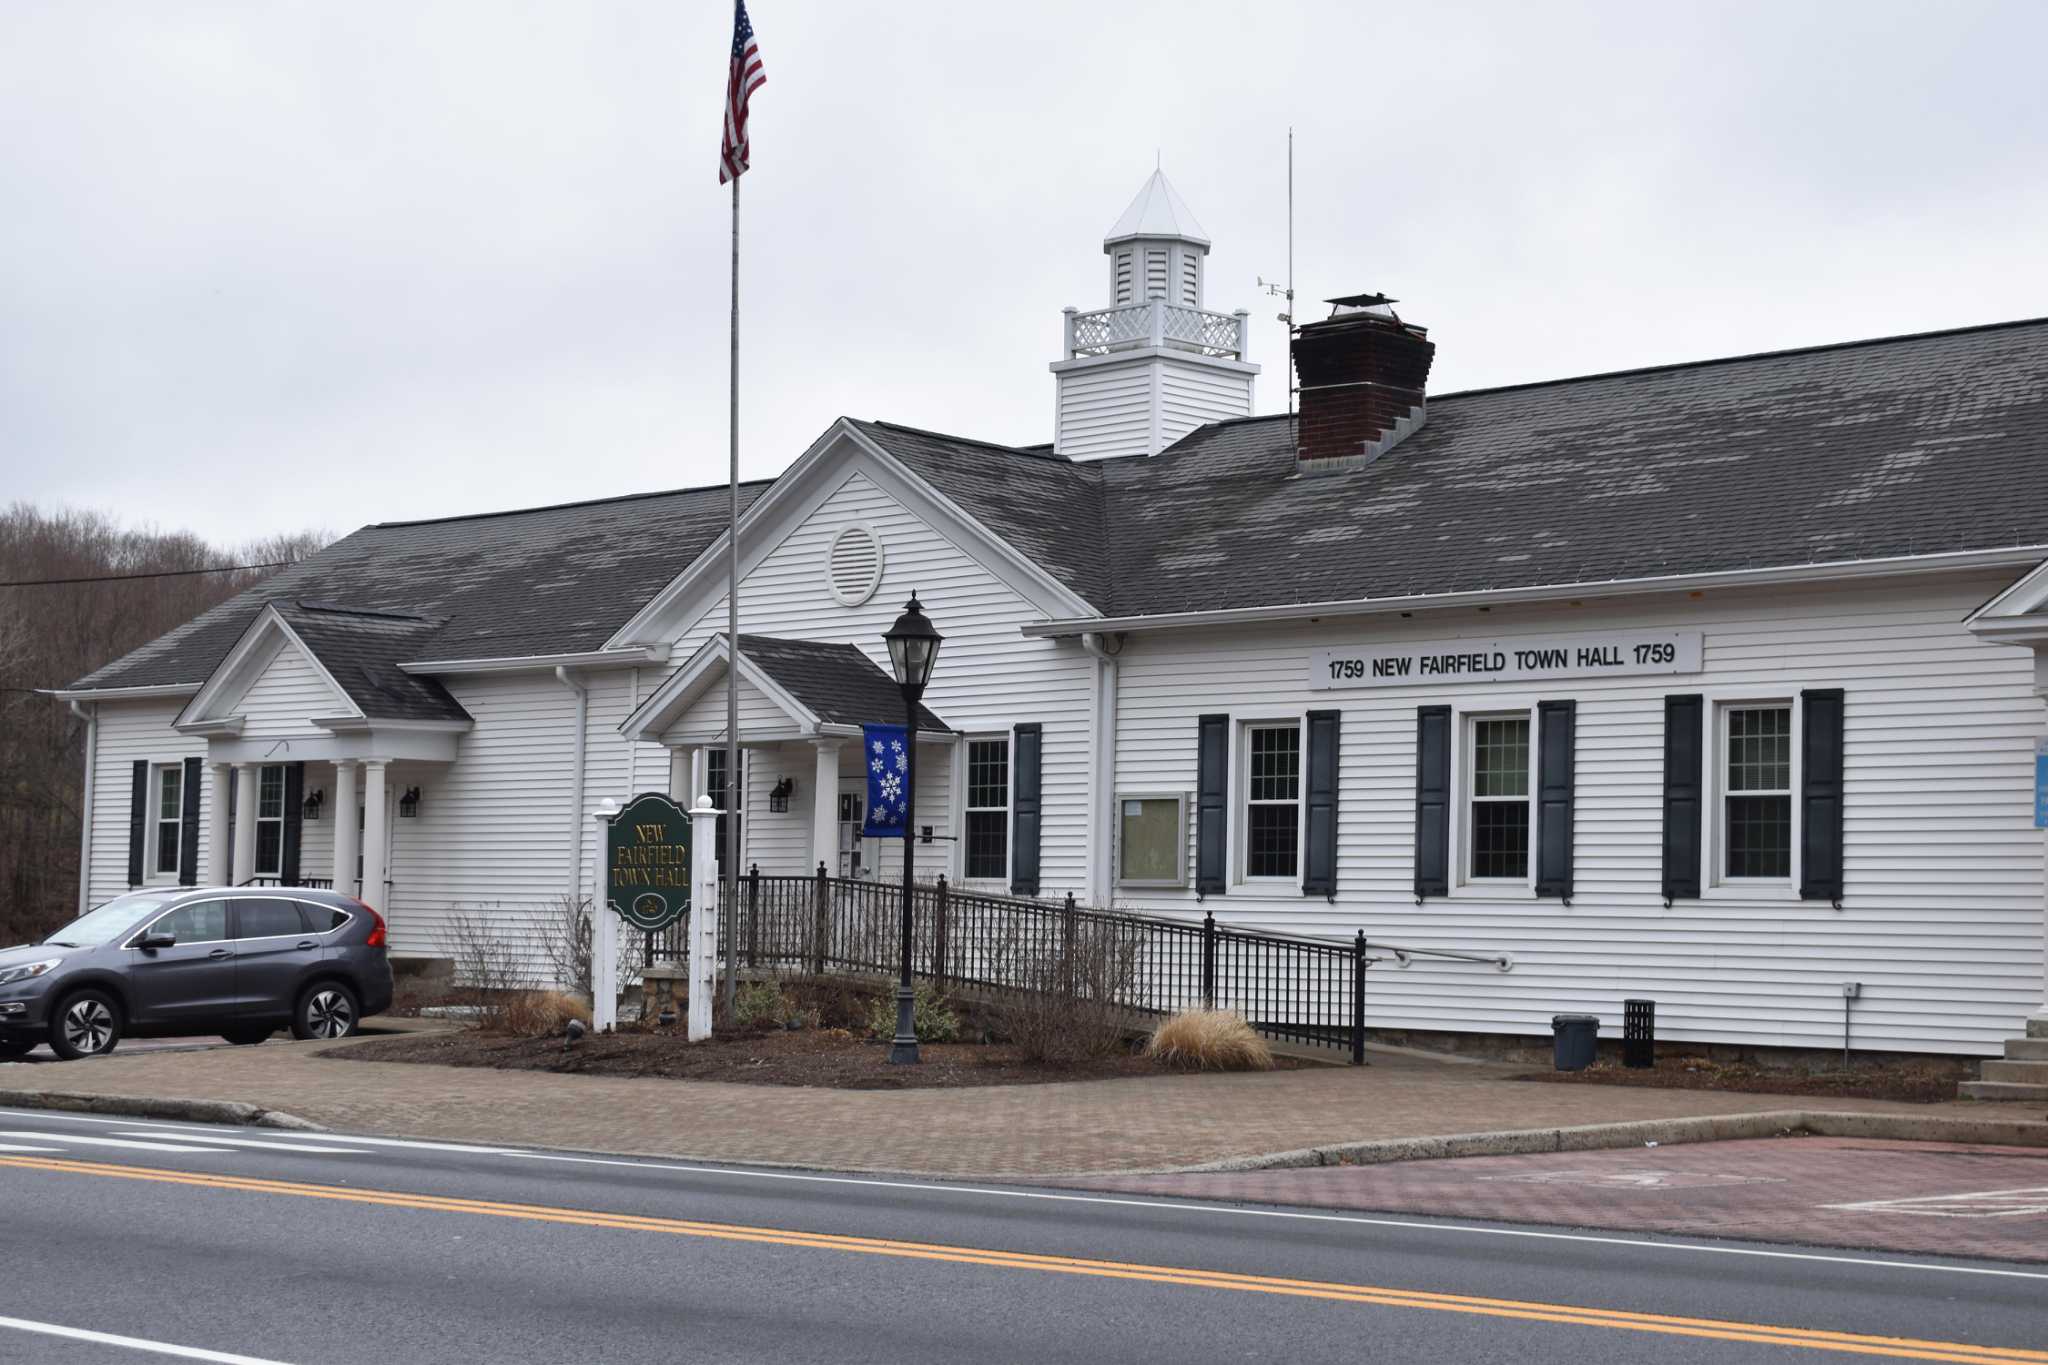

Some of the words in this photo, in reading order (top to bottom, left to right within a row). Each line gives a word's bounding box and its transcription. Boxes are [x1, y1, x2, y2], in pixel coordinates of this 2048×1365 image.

[1328, 659, 1365, 679] 1759
[1372, 656, 1412, 678] NEW
[1419, 651, 1506, 675] FAIRFIELD
[1514, 648, 1568, 670] TOWN
[1576, 646, 1625, 668] HALL
[1633, 642, 1675, 664] 1759
[634, 824, 667, 843] NEW
[616, 844, 687, 865] FAIRFIELD
[612, 867, 651, 887] TOWN
[655, 867, 689, 887] HALL
